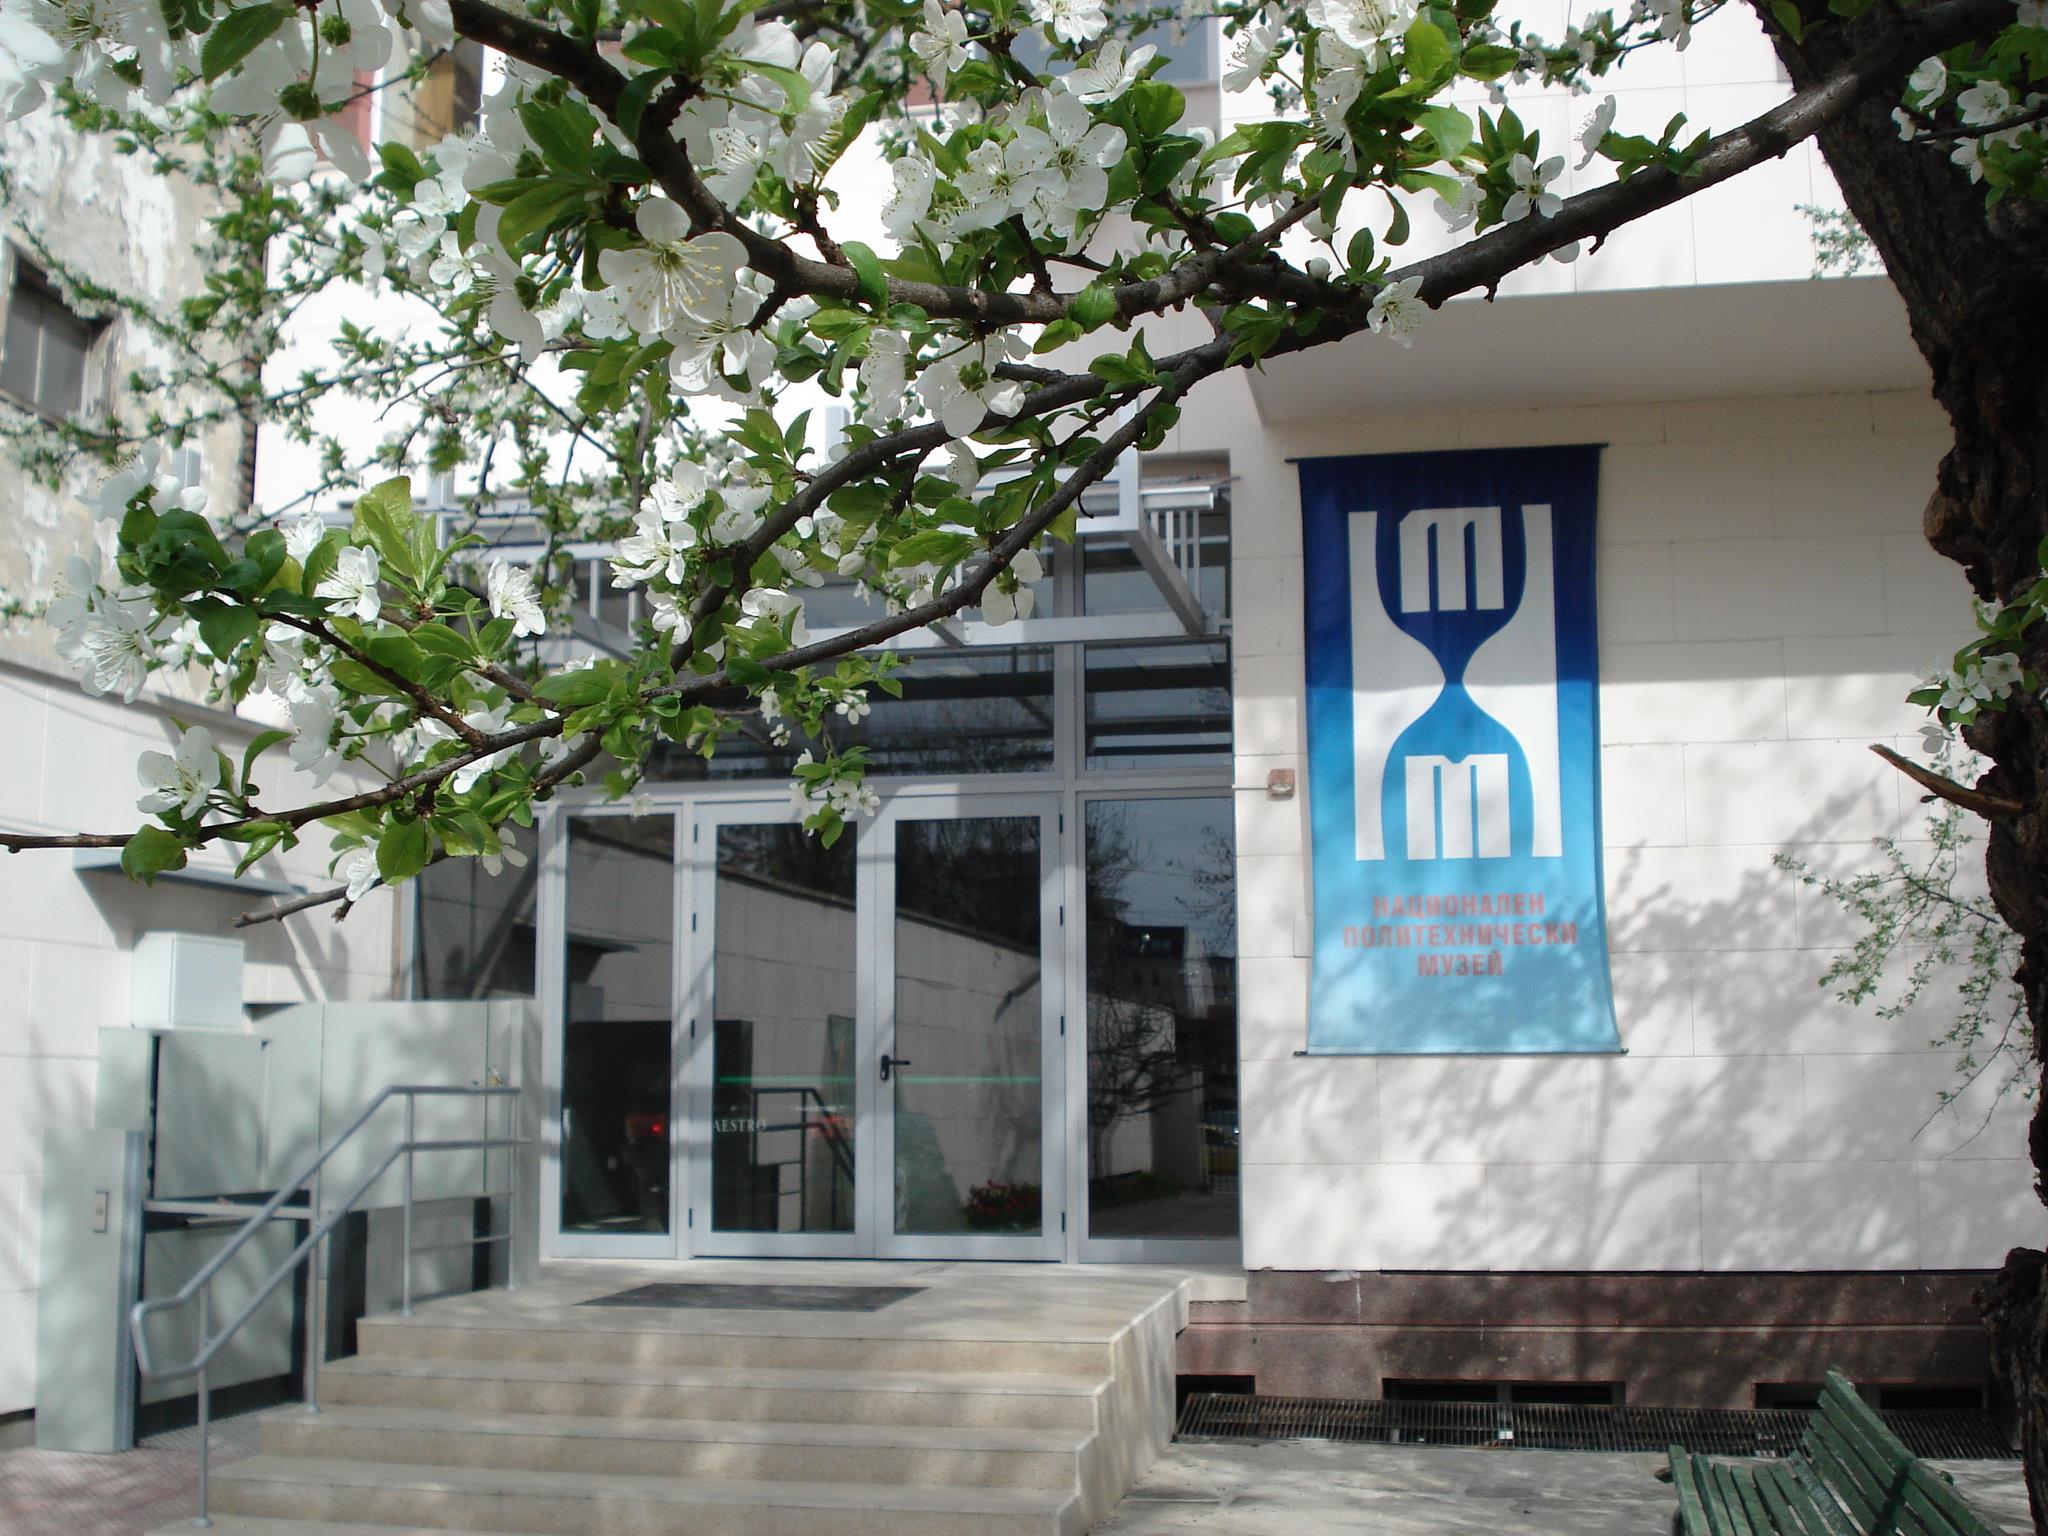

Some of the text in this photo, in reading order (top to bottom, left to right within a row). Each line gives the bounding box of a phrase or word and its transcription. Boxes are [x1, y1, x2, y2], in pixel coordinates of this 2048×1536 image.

[1373, 892, 1546, 919] НАЦИОНАЛЕН
[1343, 921, 1578, 948] ПОЛИТЕХНИЧЕСКИ
[1417, 950, 1504, 977] МУЗЕЙ
